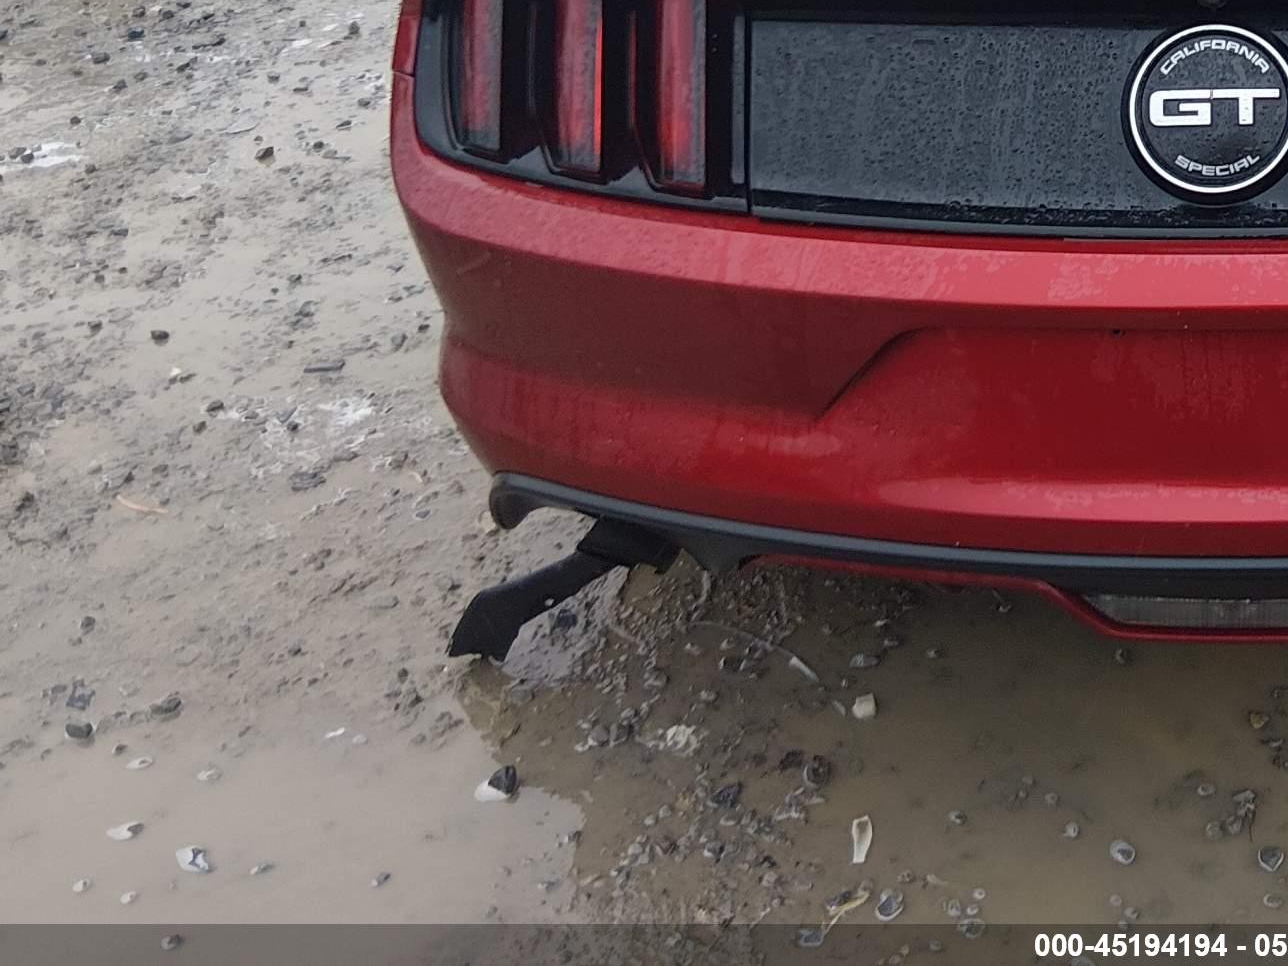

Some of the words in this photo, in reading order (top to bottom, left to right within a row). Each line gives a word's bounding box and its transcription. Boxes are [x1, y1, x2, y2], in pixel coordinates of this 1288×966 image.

[1160, 39, 1270, 75] CALIFORNIA
[1149, 88, 1281, 127] GT
[1173, 154, 1261, 176] SPECIAL
